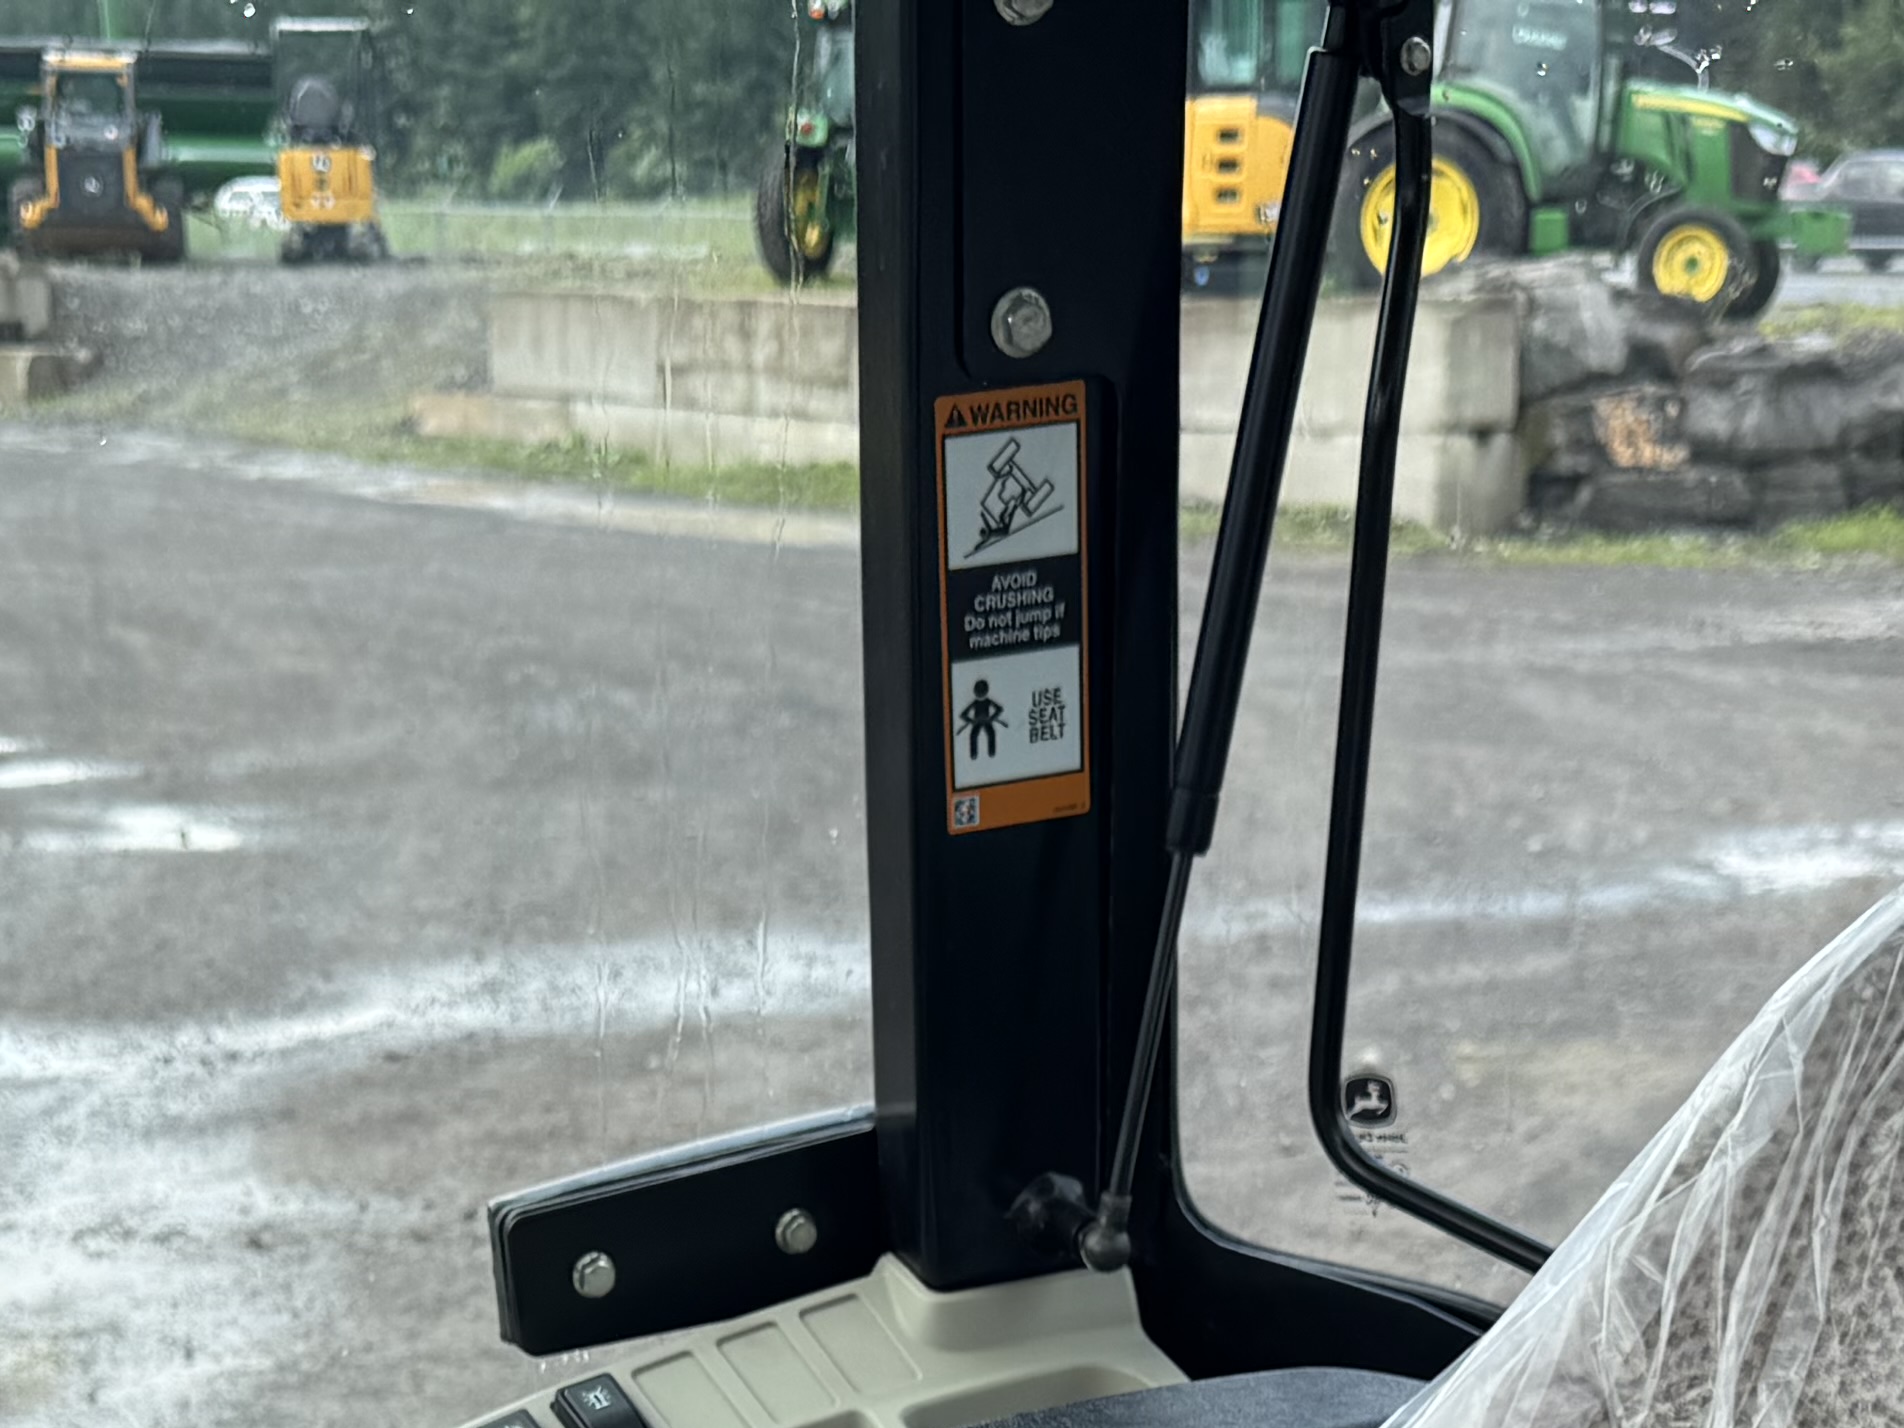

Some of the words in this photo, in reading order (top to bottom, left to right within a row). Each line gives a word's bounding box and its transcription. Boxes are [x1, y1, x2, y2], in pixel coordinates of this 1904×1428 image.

[969, 394, 1078, 426] WARNING
[992, 571, 1037, 591] AVOID
[974, 586, 1054, 612] CRUSHING
[964, 615, 985, 632] Do
[987, 611, 1012, 629] not
[1015, 608, 1052, 629] jump
[1054, 601, 1066, 619] if
[969, 628, 1030, 649] machine
[1033, 623, 1061, 643] tips
[1032, 687, 1063, 707] USE
[1029, 705, 1066, 726] SEAT
[1029, 723, 1066, 743] BELT
